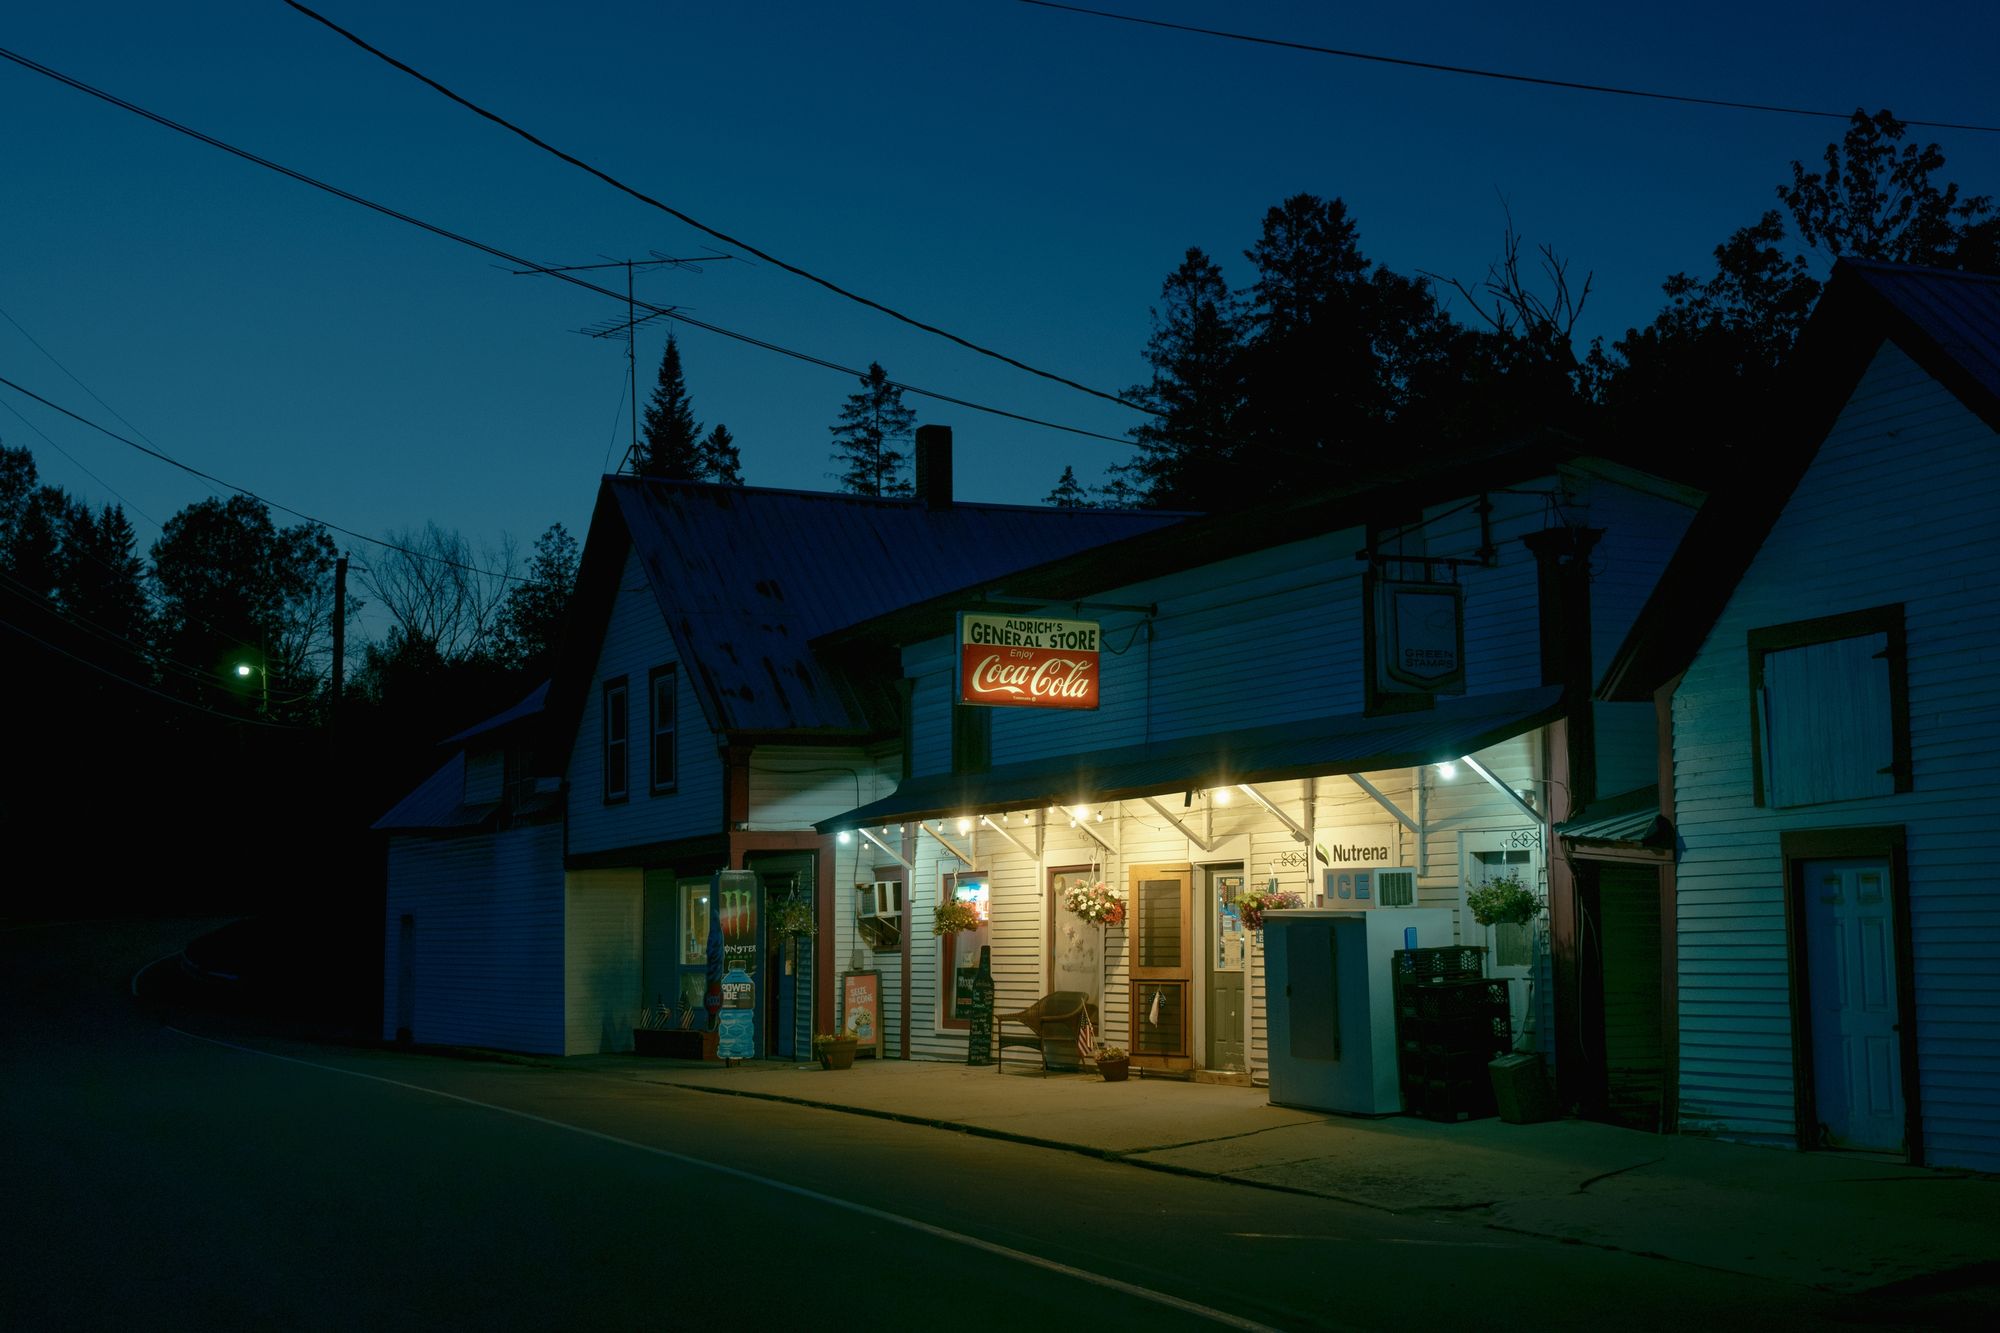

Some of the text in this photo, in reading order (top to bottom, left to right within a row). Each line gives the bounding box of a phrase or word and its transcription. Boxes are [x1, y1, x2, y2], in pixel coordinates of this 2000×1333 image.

[1005, 619, 1063, 634] ALDRICH'S
[970, 622, 1096, 651] GENERAL STORE
[1010, 648, 1034, 660] Enjoy
[1404, 648, 1454, 659] GREEN
[1405, 658, 1454, 669] STAMPS
[971, 654, 1093, 698] Coca-Cola
[1333, 844, 1388, 862] Nutrena
[1326, 873, 1371, 900] ICE
